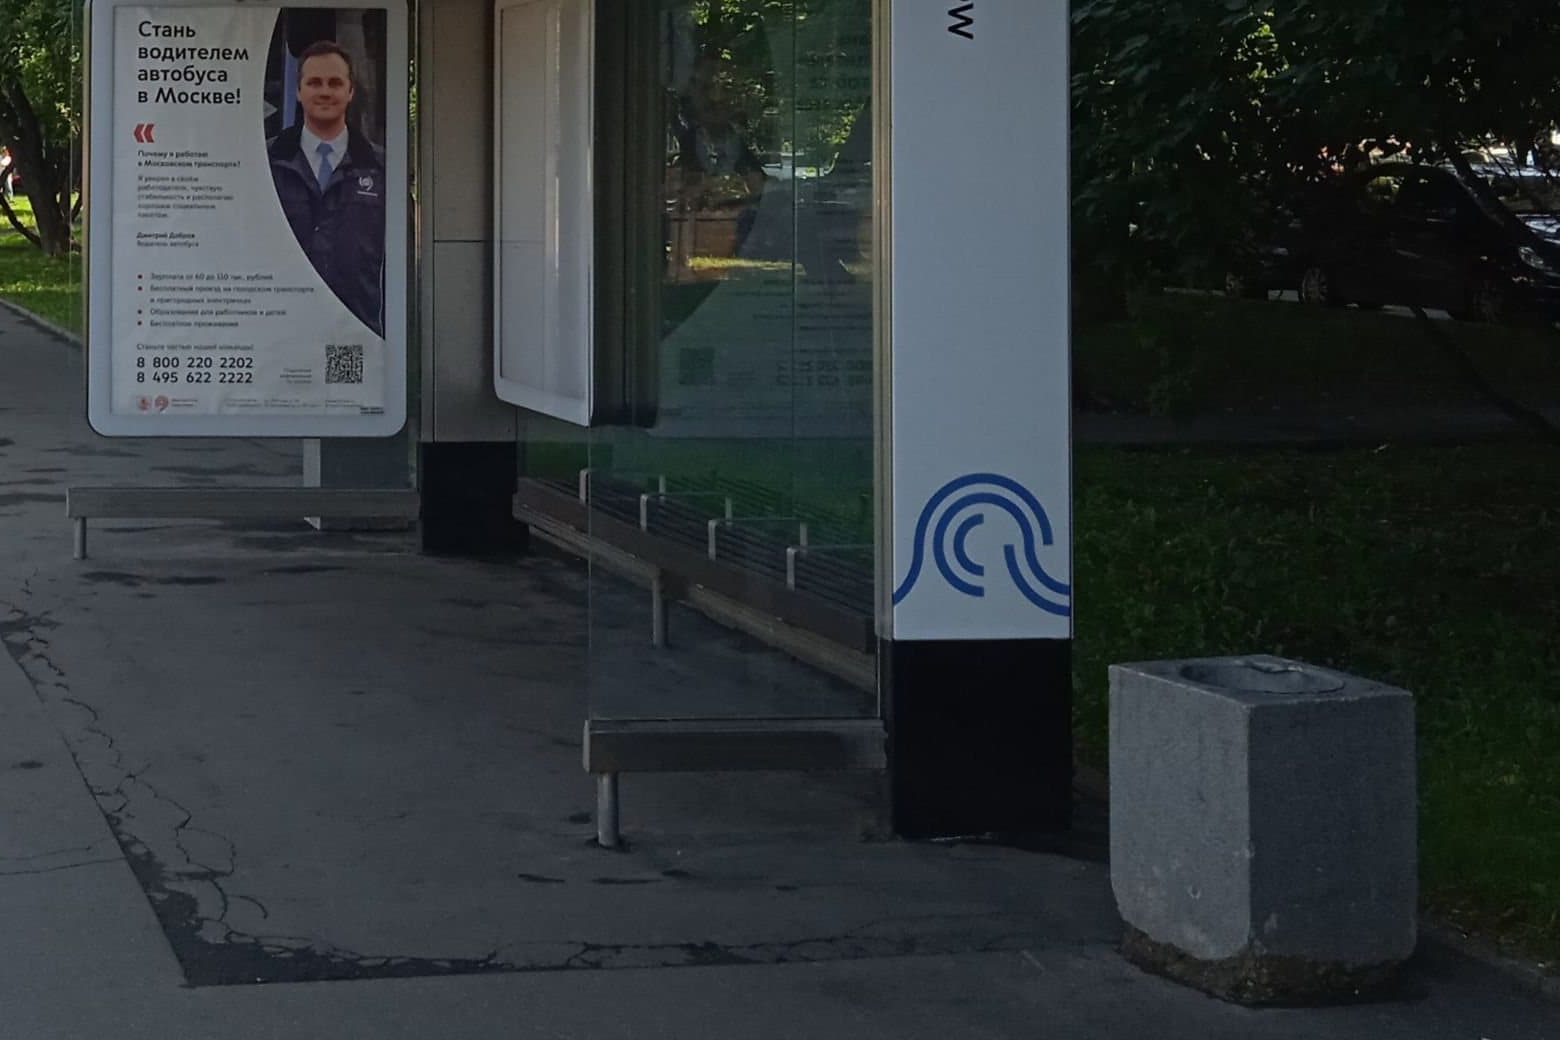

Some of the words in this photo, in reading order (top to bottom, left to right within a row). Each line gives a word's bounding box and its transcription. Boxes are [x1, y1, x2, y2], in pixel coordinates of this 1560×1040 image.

[138, 20, 196, 38] Стань
[138, 47, 249, 62] водителем
[138, 65, 228, 86] автобуса
[138, 91, 148, 103] в
[155, 87, 241, 104] Москве!
[136, 357, 145, 368] 8
[153, 357, 180, 368] 800
[187, 357, 213, 368] 220
[220, 357, 253, 368] 2202
[136, 371, 145, 383] 8
[152, 371, 178, 383] 495
[186, 371, 211, 383] 622
[219, 371, 253, 383] 2222
